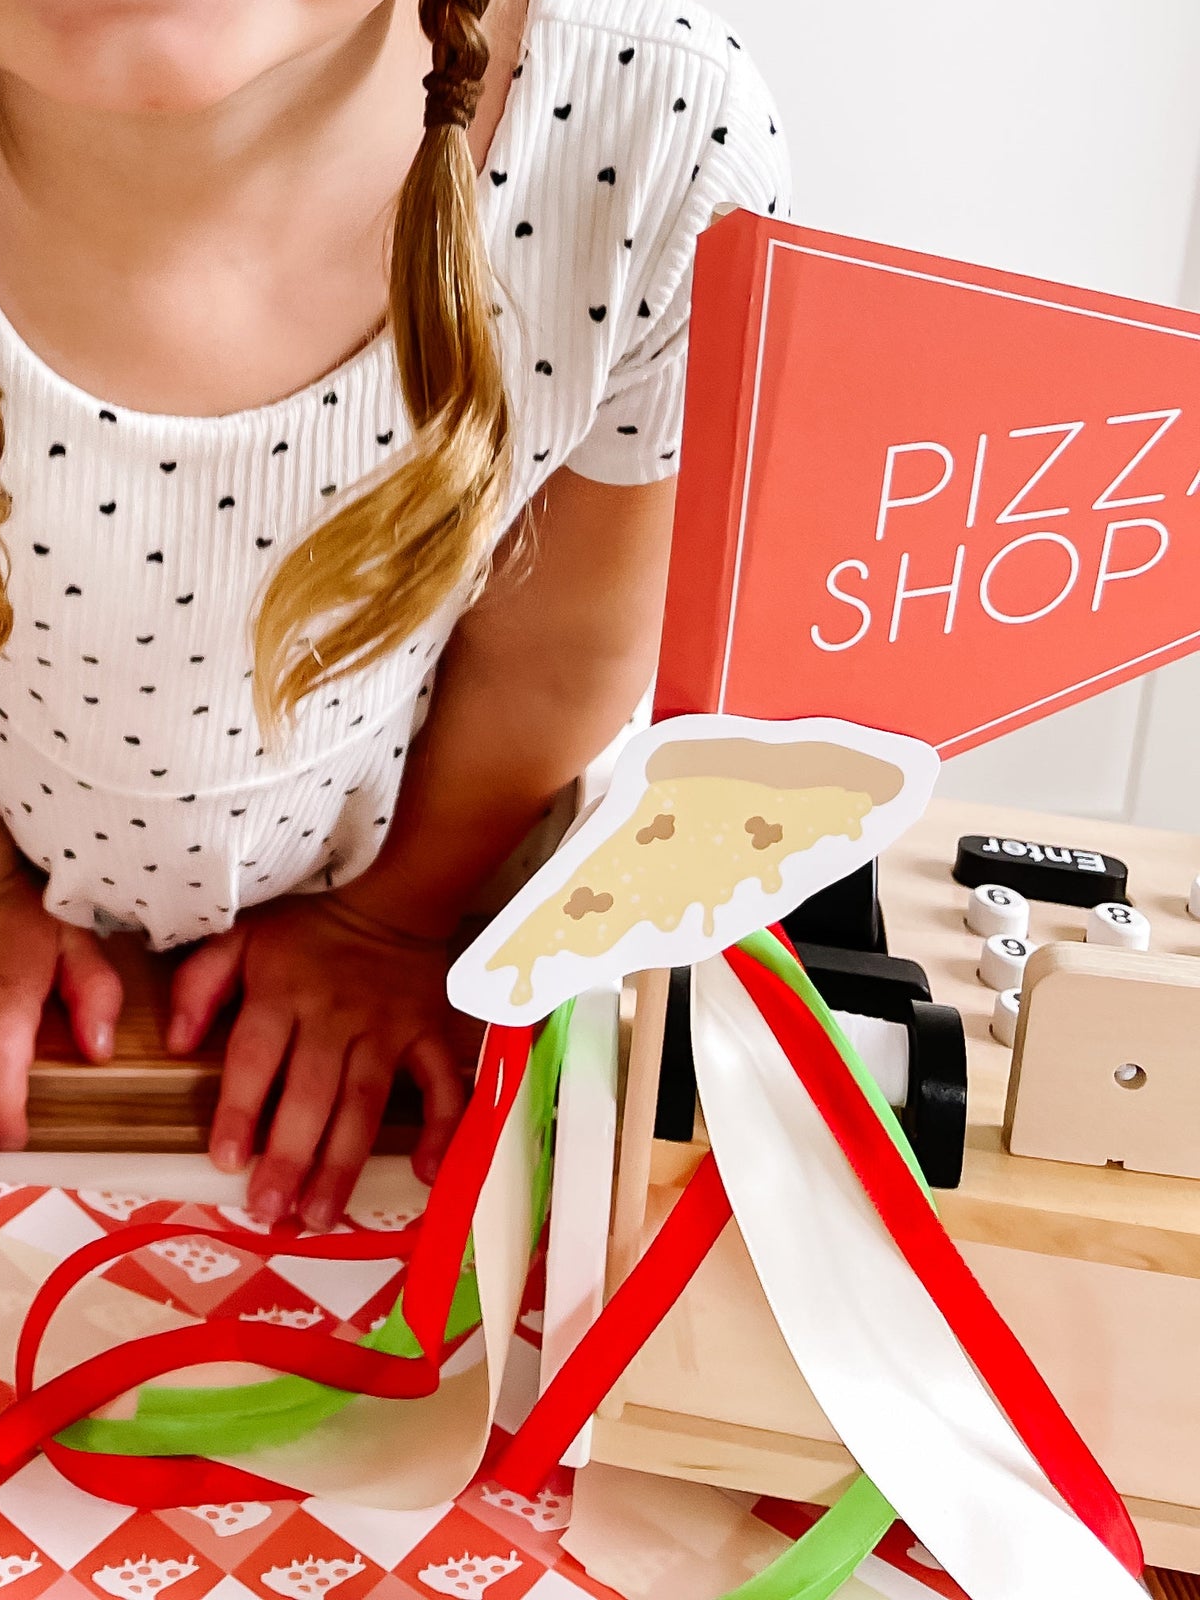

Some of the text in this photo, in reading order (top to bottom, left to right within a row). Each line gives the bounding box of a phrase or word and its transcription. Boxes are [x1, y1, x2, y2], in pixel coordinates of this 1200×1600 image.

[875, 408, 1200, 541] PIZZ
[810, 517, 1169, 652] SHOP
[982, 836, 1106, 874] Enter
